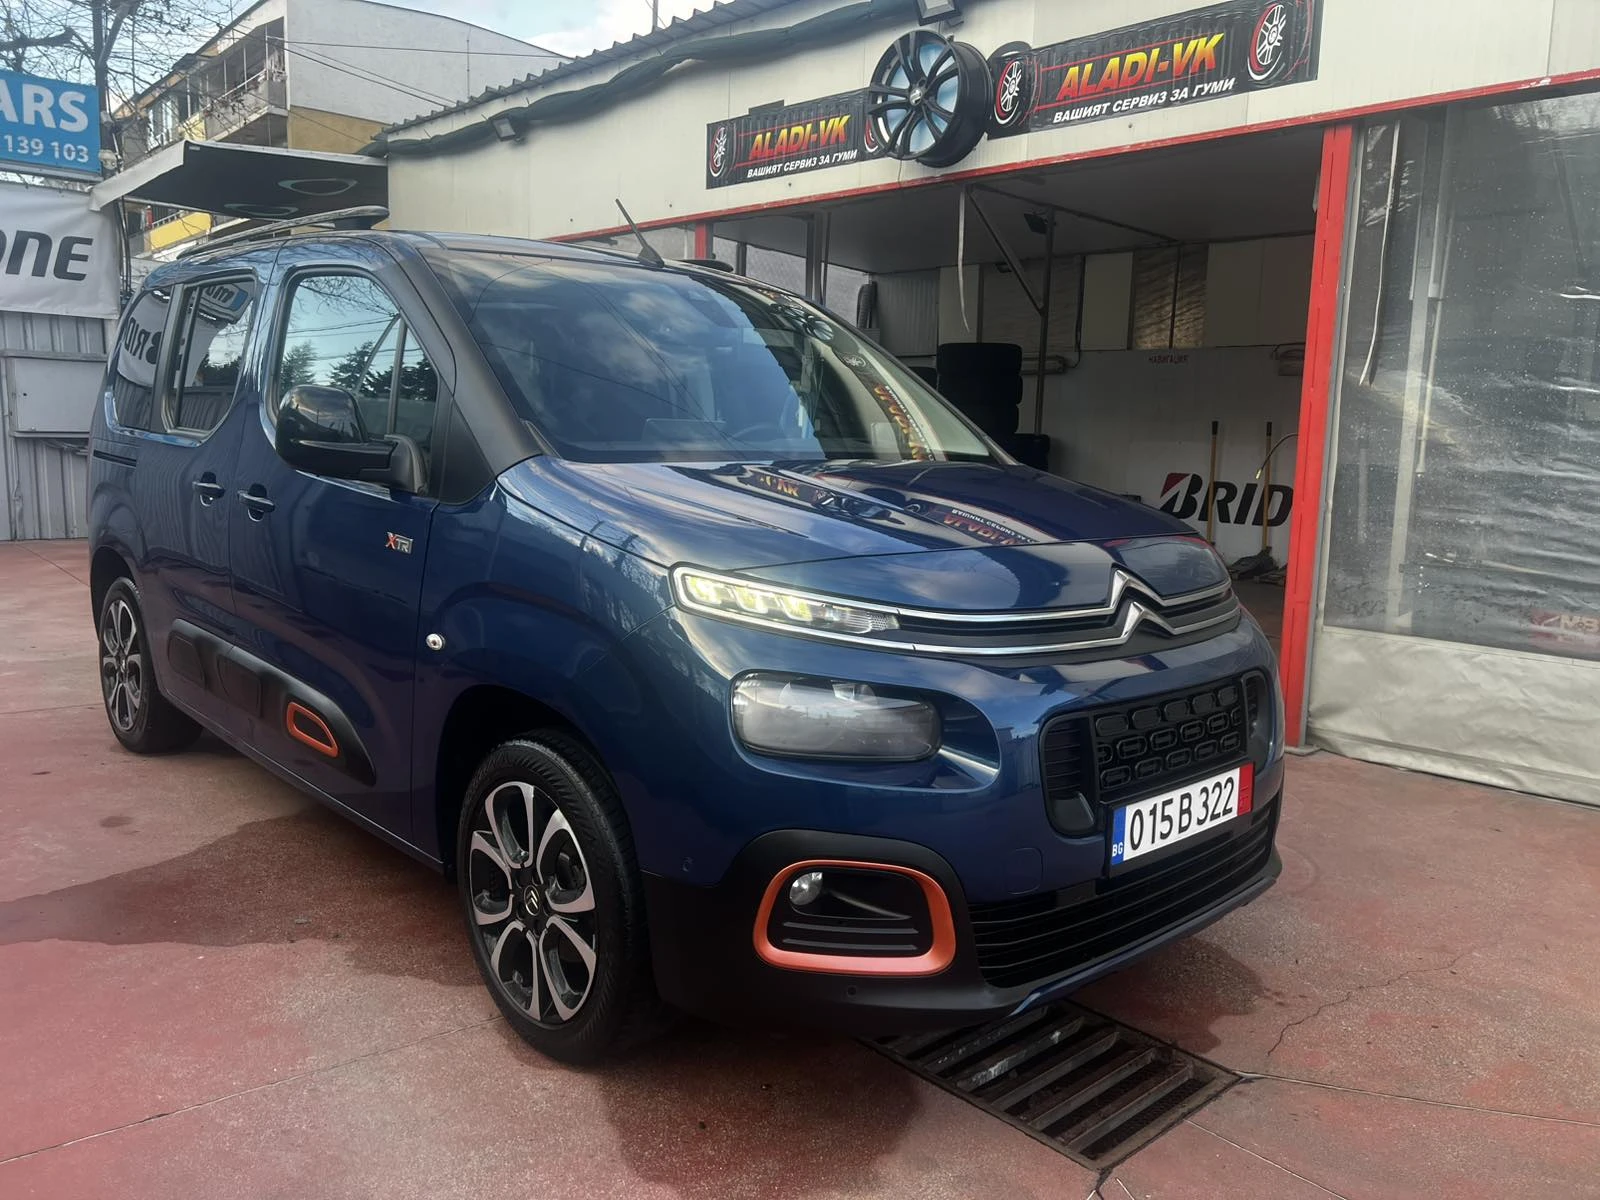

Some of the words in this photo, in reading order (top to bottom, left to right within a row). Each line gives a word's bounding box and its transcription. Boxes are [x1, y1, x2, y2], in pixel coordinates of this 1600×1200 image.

[1055, 32, 1225, 101] ALADI-VK
[1053, 102, 1111, 123] ВАШИЯТ
[1112, 91, 1167, 112] СЕРВИЗ
[1169, 89, 1189, 102] ЗА
[1192, 77, 1236, 98] ГУМИ
[4, 134, 44, 156] 139
[50, 141, 90, 163] 103
[748, 114, 851, 161] ALADI-VK
[747, 163, 783, 179] ВАШИЯТ
[783, 157, 817, 172] СЕРВИЗ
[818, 156, 831, 166] ЗА
[831, 149, 858, 163] ГУМИ
[0, 229, 94, 282] NE
[1160, 472, 1293, 528] BRID
[385, 531, 413, 554] XTR
[1111, 842, 1124, 857] BG
